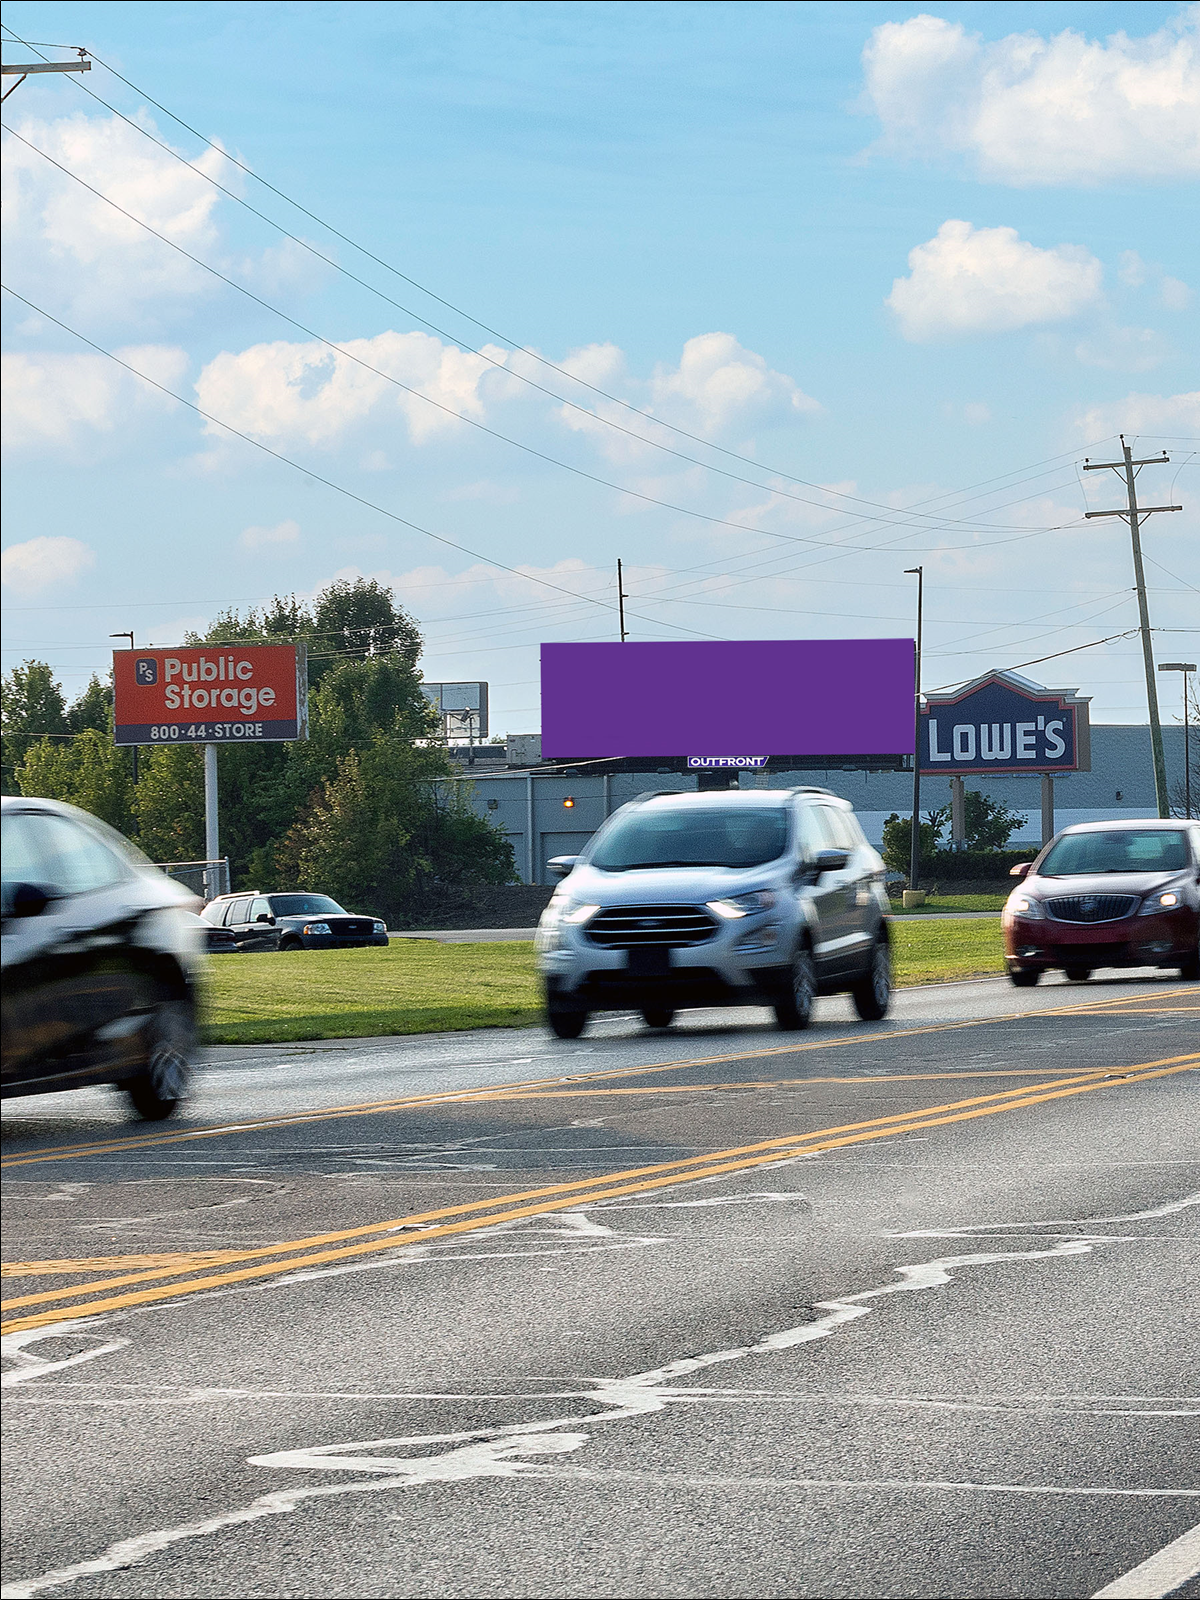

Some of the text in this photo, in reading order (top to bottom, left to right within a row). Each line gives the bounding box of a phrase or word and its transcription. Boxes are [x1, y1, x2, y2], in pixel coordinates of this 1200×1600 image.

[164, 655, 253, 682] Public
[164, 684, 276, 715] Storage
[928, 715, 1066, 762] LOWE'S
[690, 757, 764, 766] OUTFRONT
